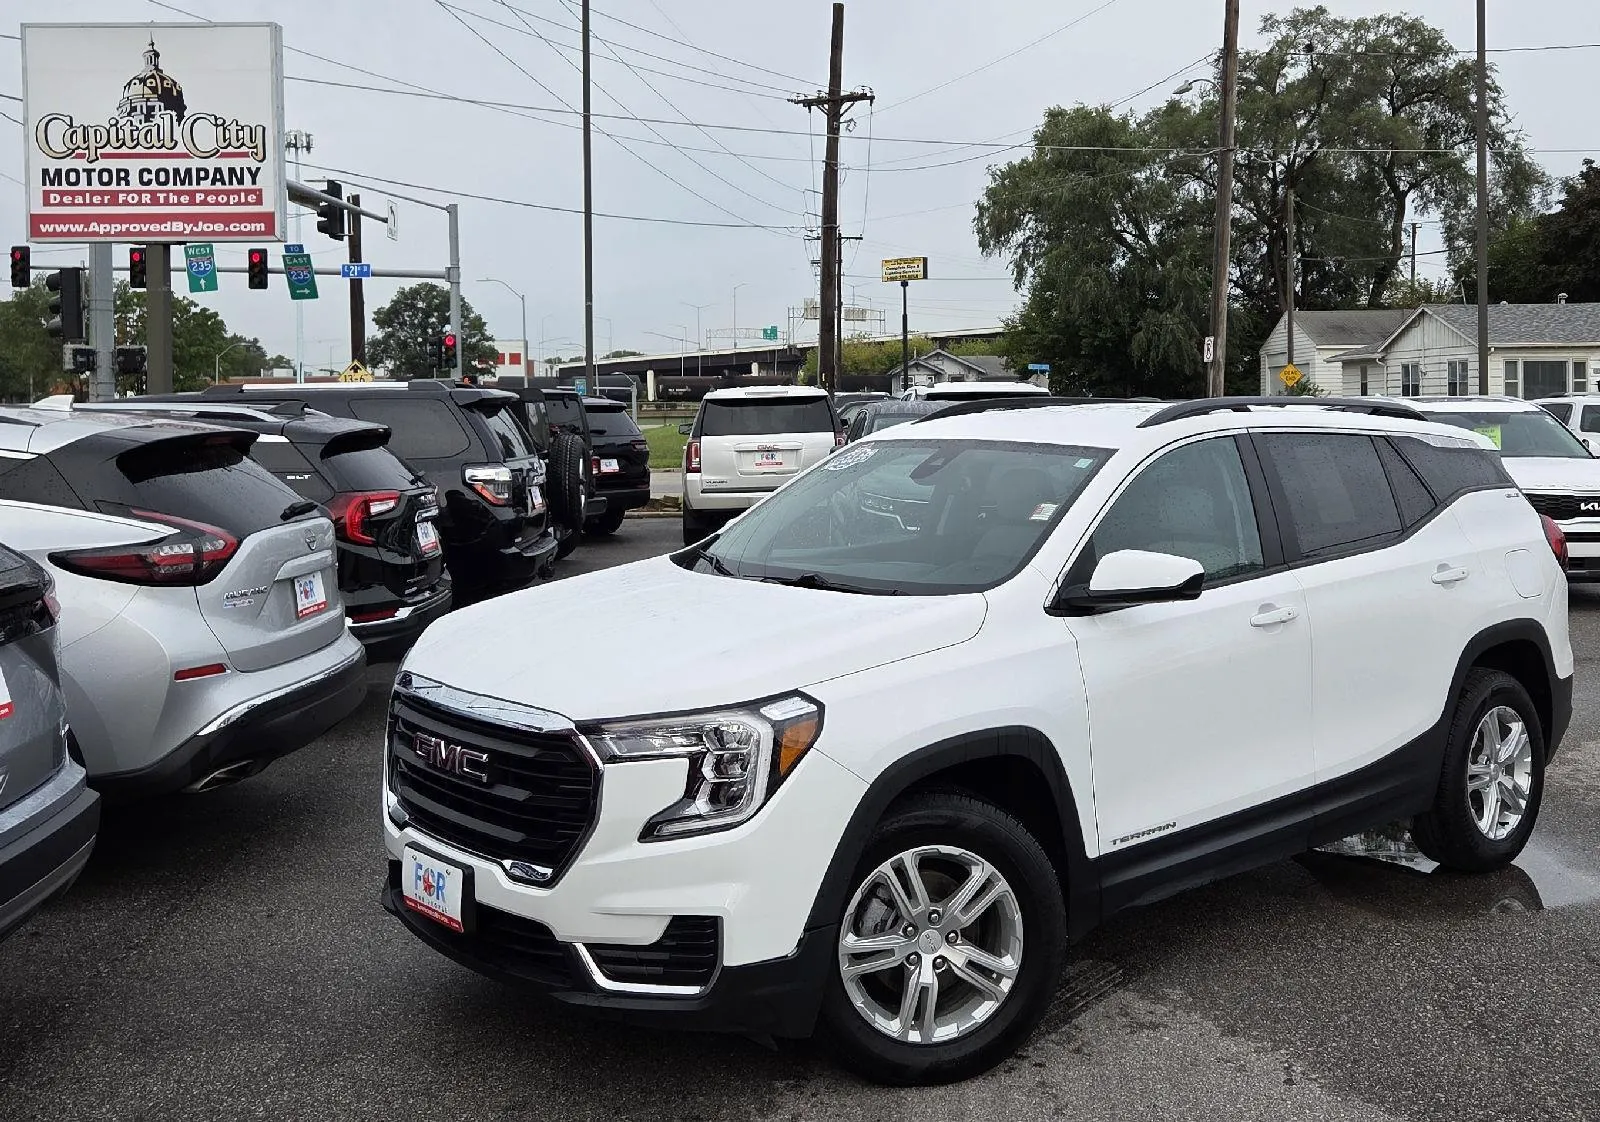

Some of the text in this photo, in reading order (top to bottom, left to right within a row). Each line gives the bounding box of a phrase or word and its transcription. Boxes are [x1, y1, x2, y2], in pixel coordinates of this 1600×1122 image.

[36, 112, 266, 163] Capital City
[41, 166, 261, 187] MOTOR COMPANY
[49, 193, 111, 204] Dealer
[118, 193, 151, 204] FOR
[157, 192, 190, 204] The
[39, 221, 265, 235] www.ApprovedByJoe.com
[187, 247, 211, 255] WEST
[191, 260, 212, 272] 235
[286, 256, 307, 264] EAST
[290, 270, 310, 280] 235
[412, 731, 489, 783] GMC
[1110, 821, 1177, 846] TERRAIN
[414, 862, 446, 903] FOR
